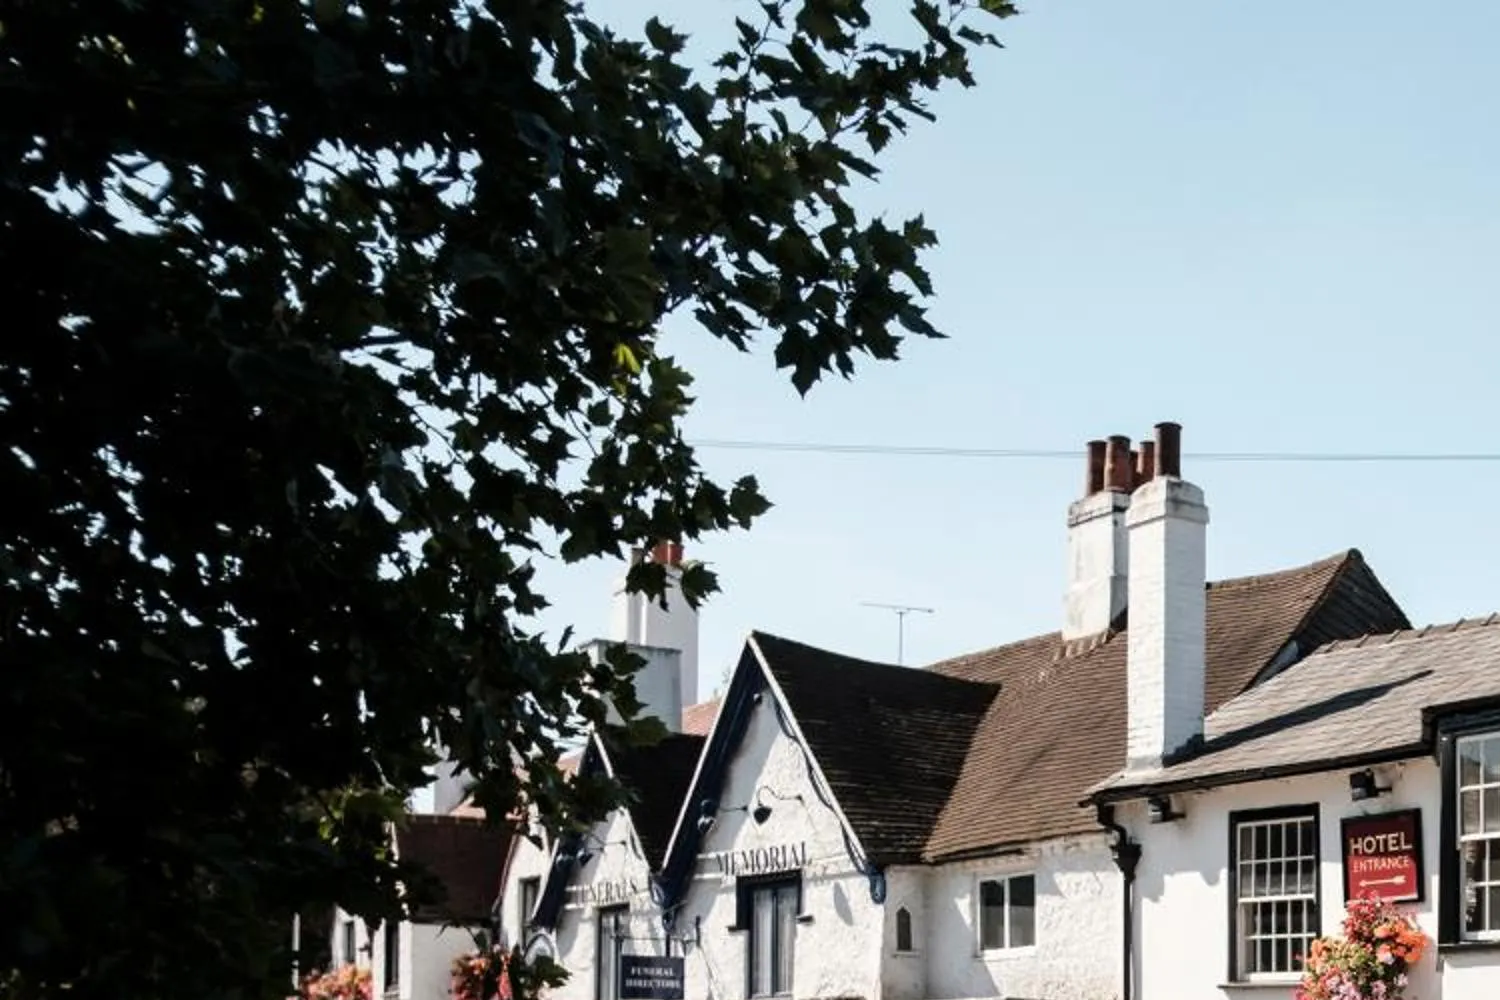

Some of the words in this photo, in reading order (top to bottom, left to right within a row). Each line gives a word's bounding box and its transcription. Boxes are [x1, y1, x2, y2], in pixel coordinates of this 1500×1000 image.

[1349, 831, 1413, 856] HOTEL
[716, 841, 812, 875] MEMORIAL
[1353, 855, 1409, 873] ENTRANCE
[575, 879, 638, 905] UNERALS
[630, 966, 675, 977] FUNERAL
[624, 978, 681, 989] DIRECTORS
